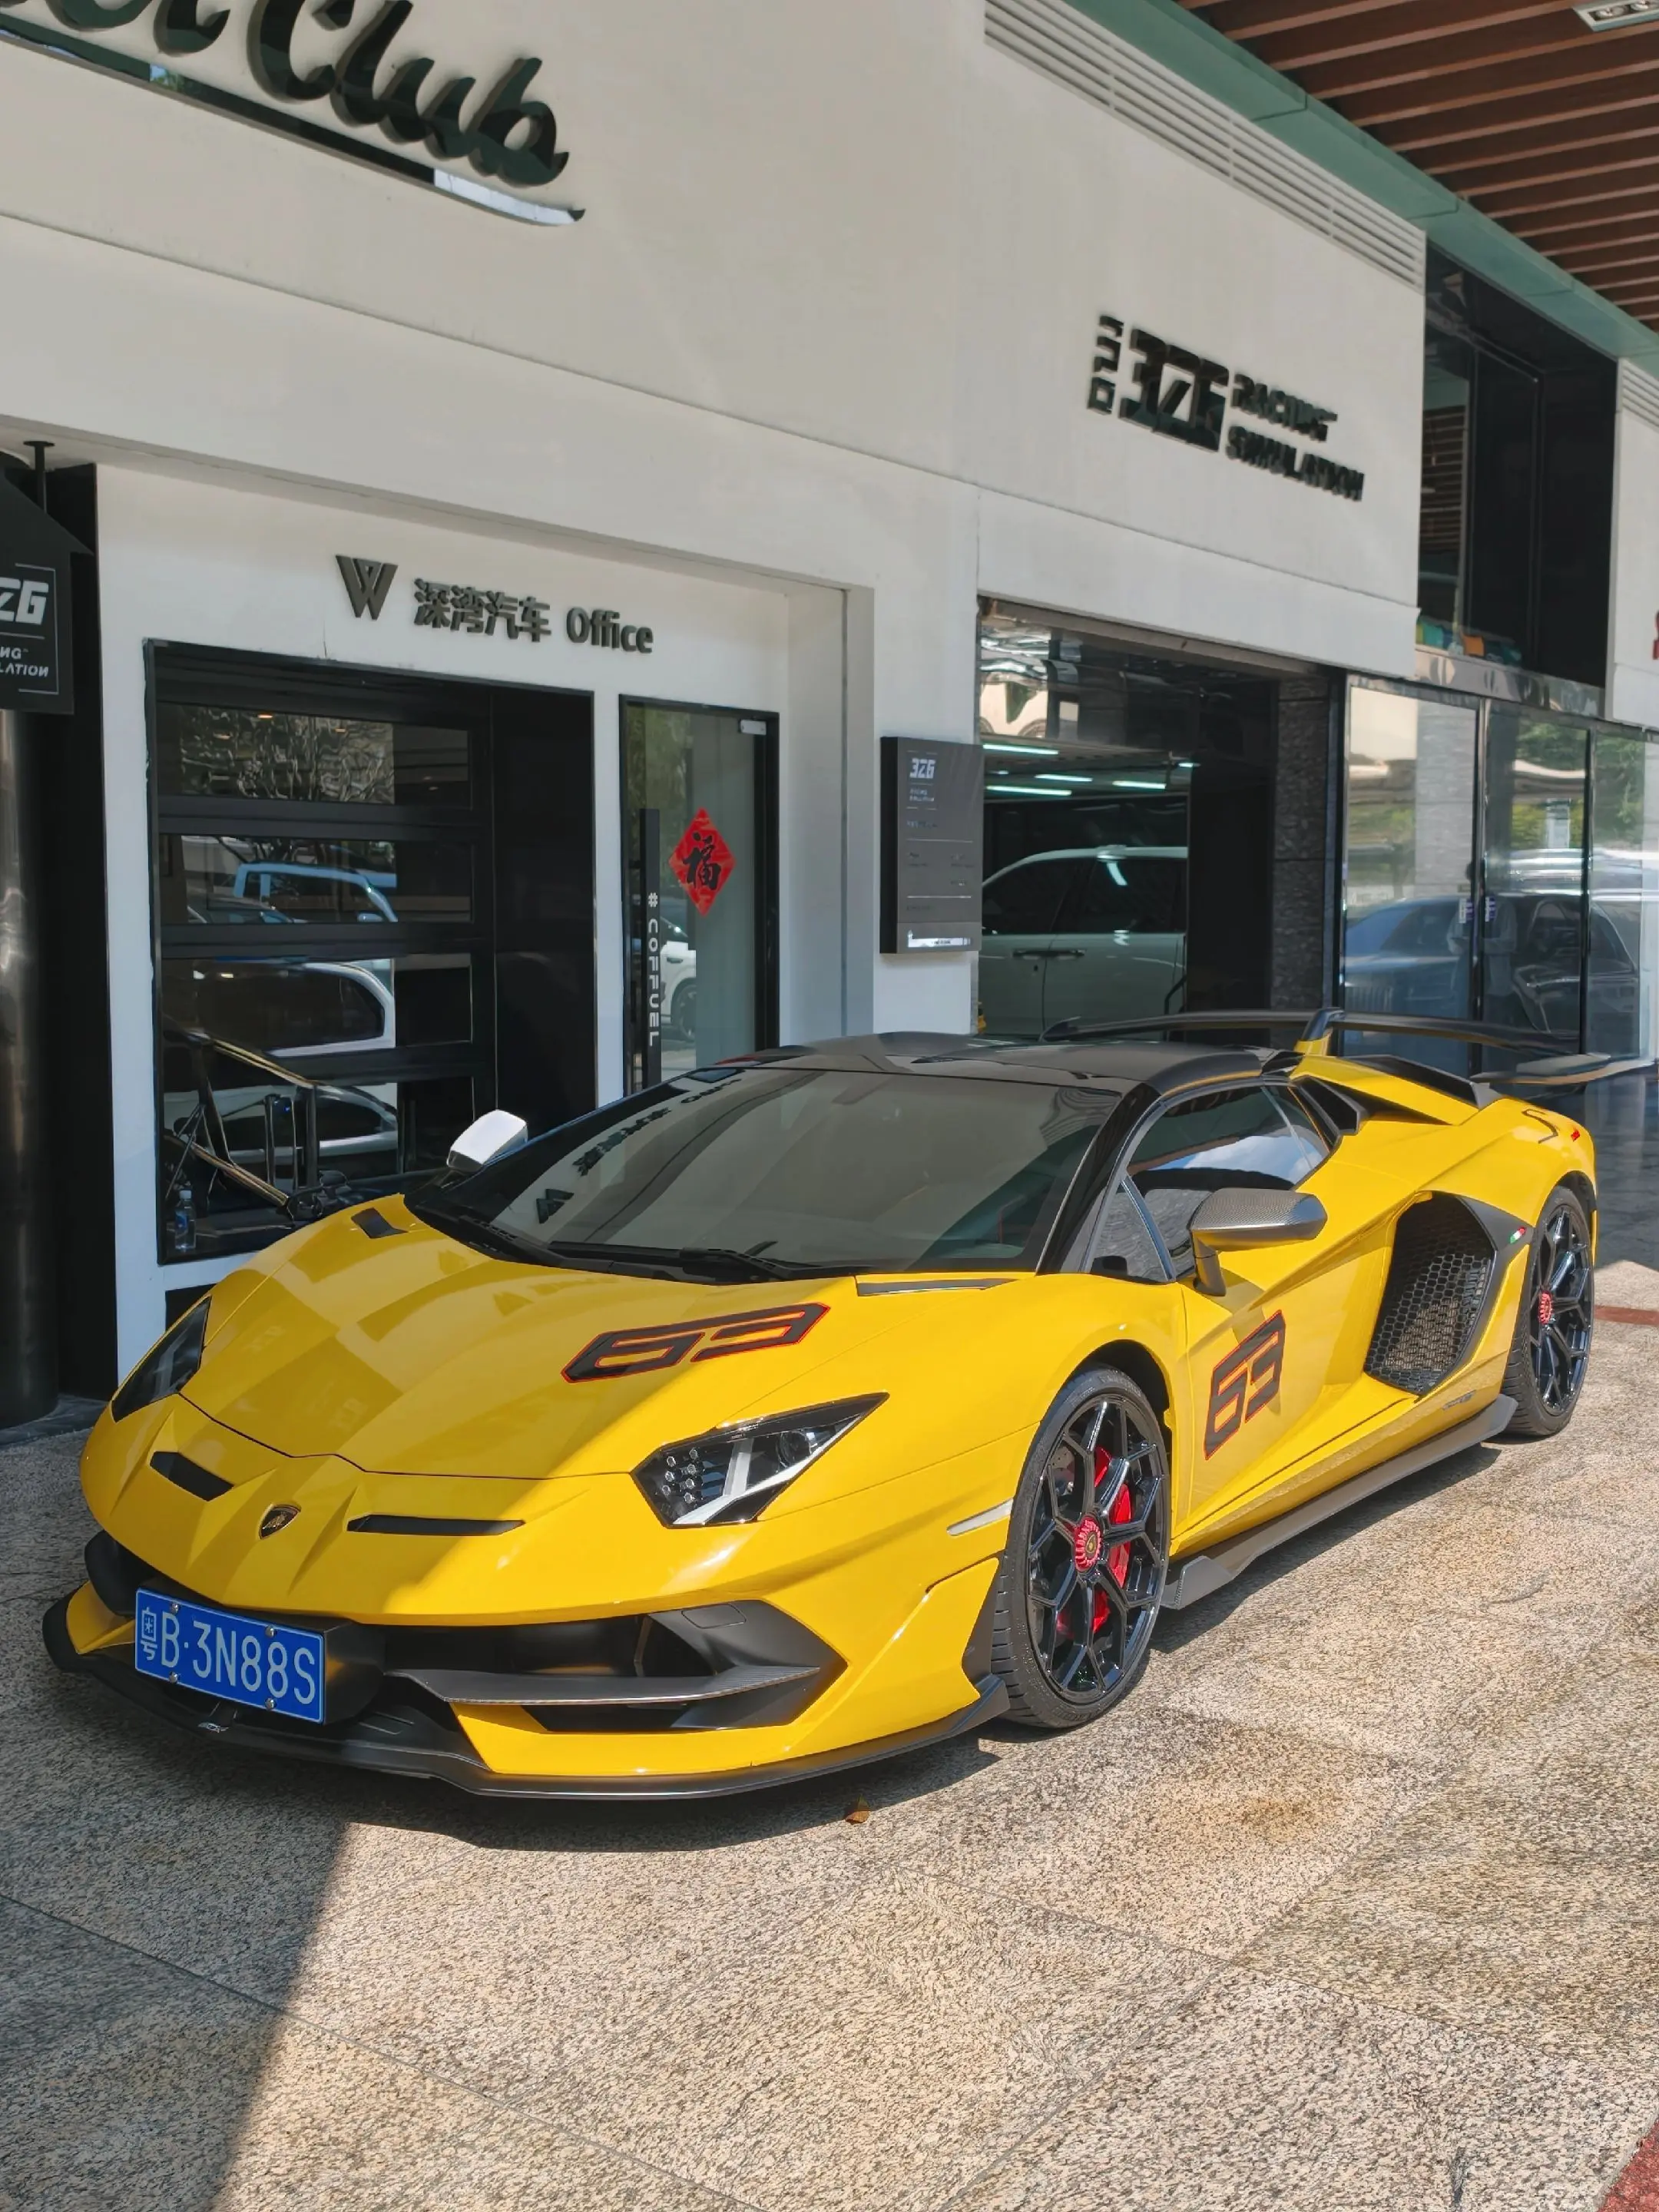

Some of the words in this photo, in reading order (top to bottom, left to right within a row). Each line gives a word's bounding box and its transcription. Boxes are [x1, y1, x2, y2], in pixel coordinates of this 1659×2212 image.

[247, 0, 570, 187] Club
[413, 578, 552, 643] 深湾汽车
[566, 606, 654, 654] Office
[682, 832, 722, 891] 福
[561, 1302, 831, 1383] 63
[1203, 1309, 1286, 1461] 63
